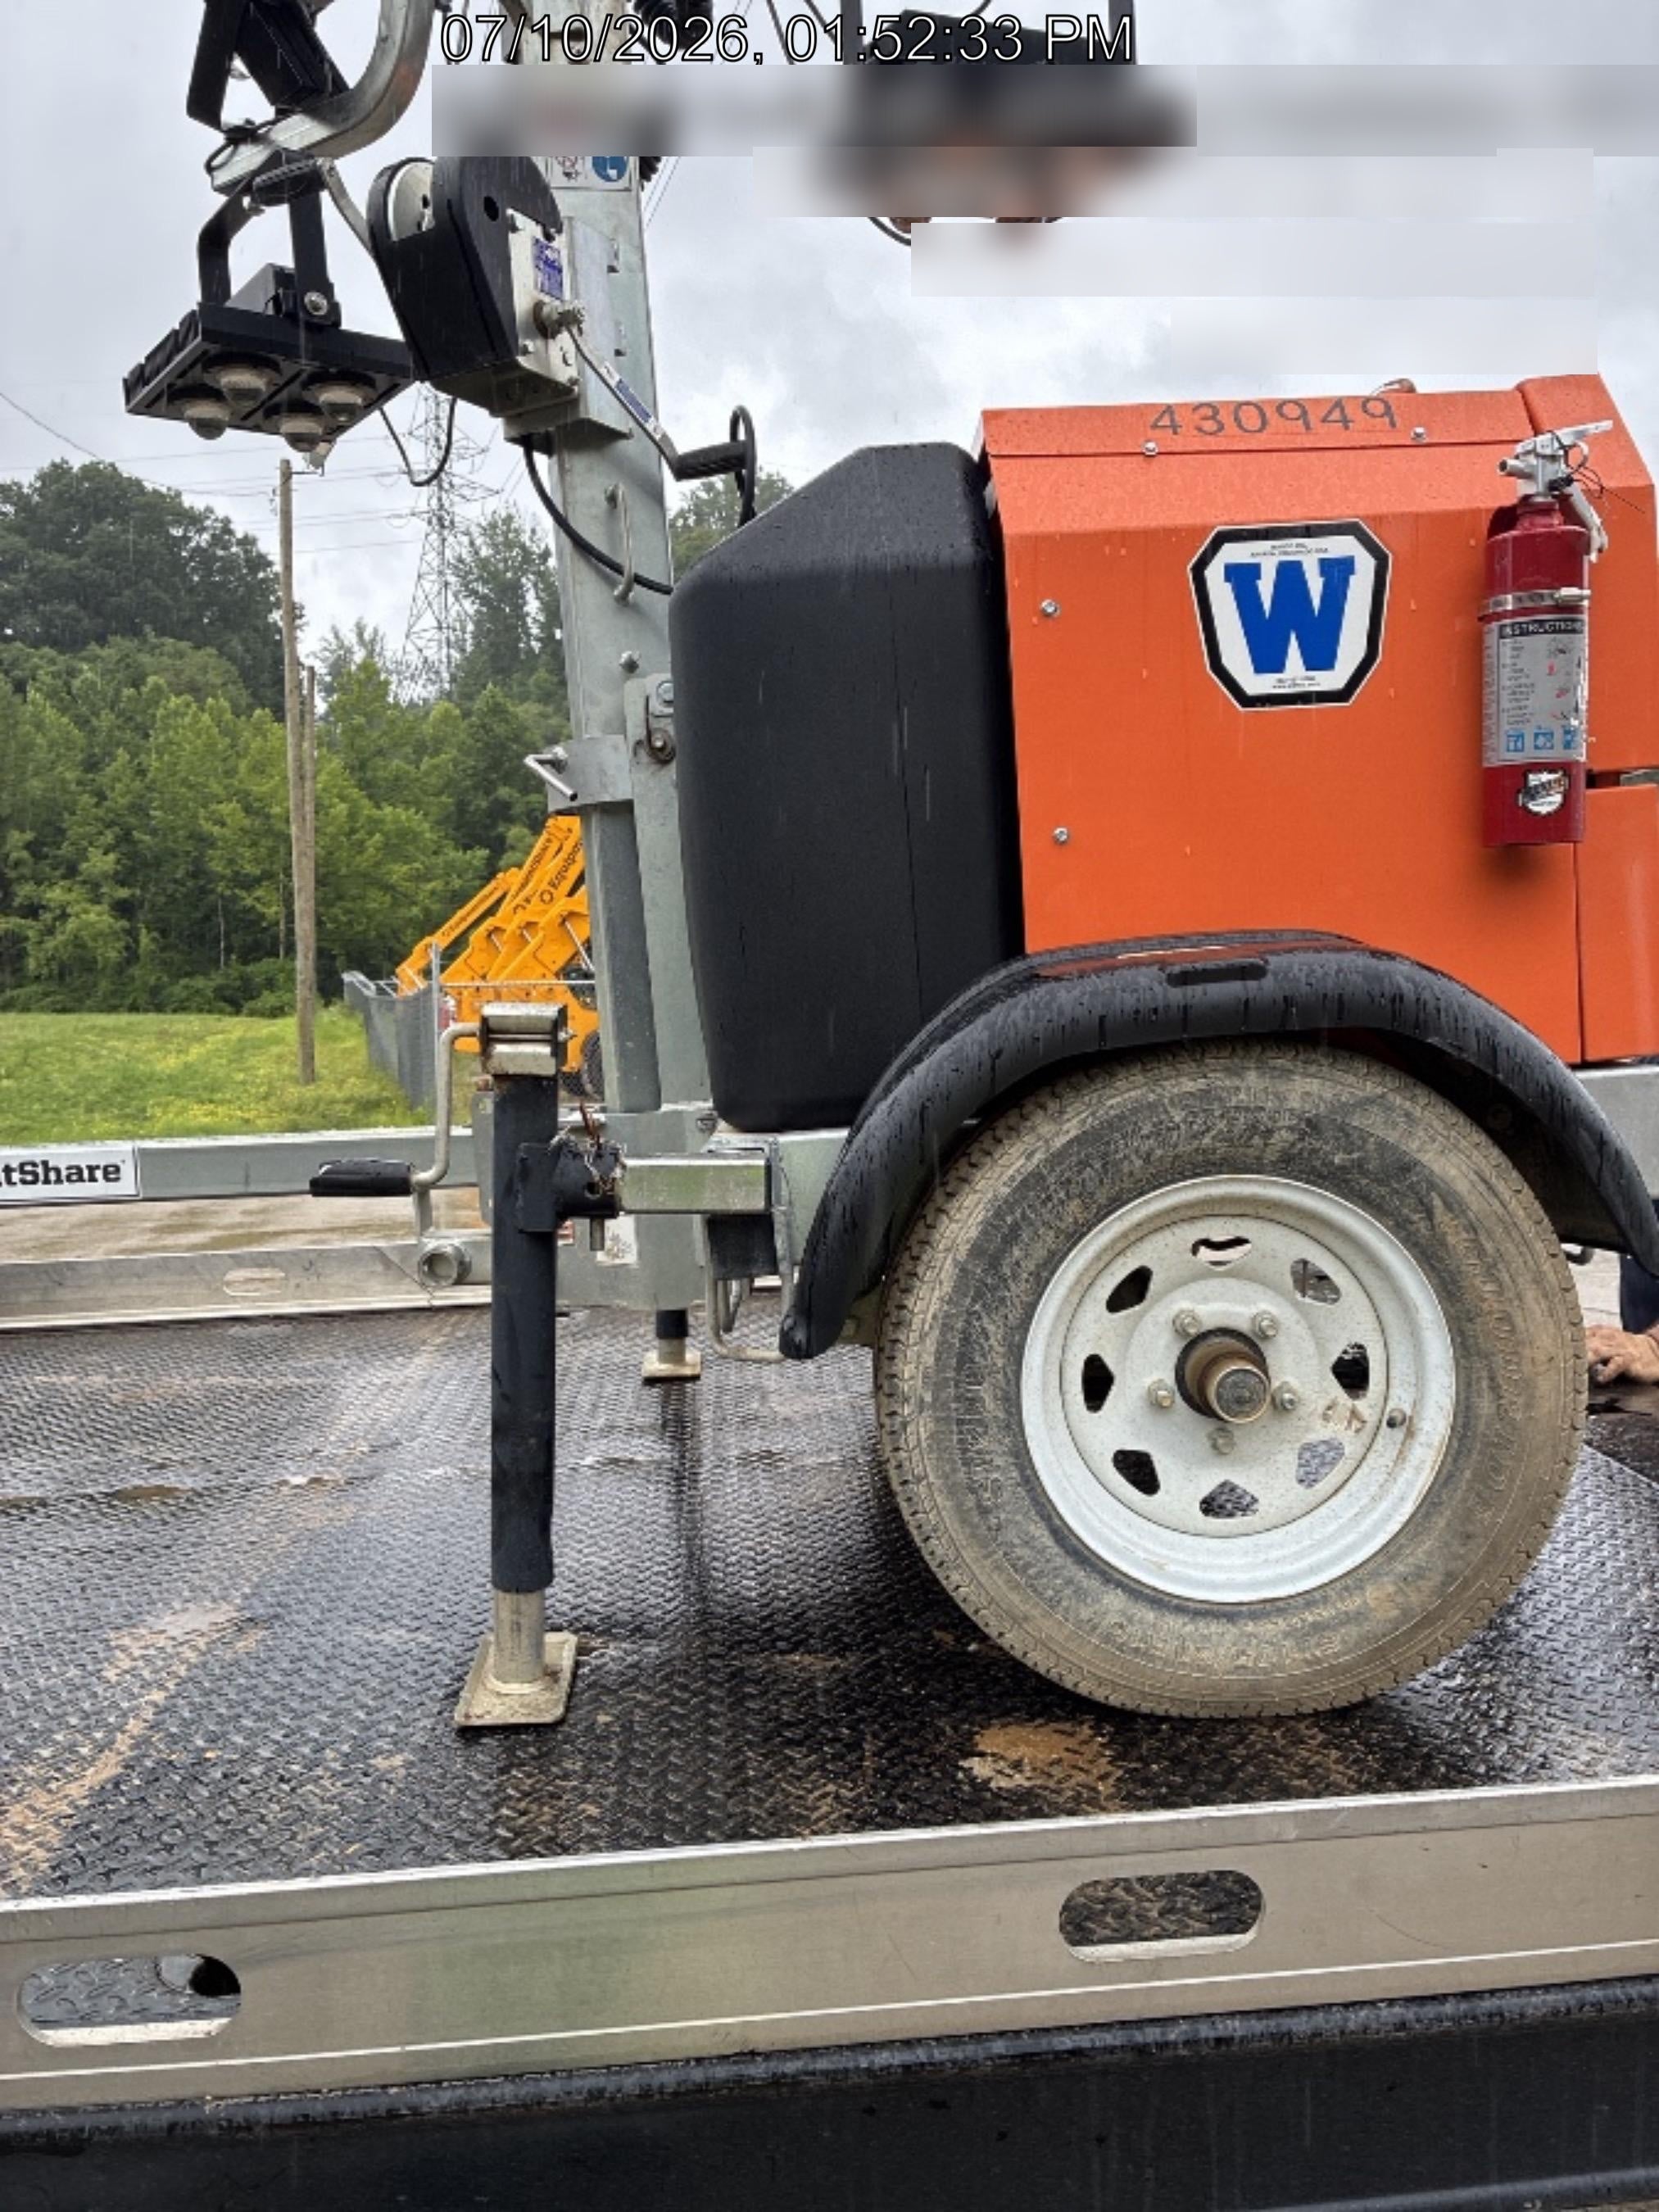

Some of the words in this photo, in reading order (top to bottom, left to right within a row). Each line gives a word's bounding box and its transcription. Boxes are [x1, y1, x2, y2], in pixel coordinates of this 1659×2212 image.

[1149, 397, 1397, 436] 430949
[1223, 555, 1355, 673] W
[0, 1159, 121, 1186] tShare
